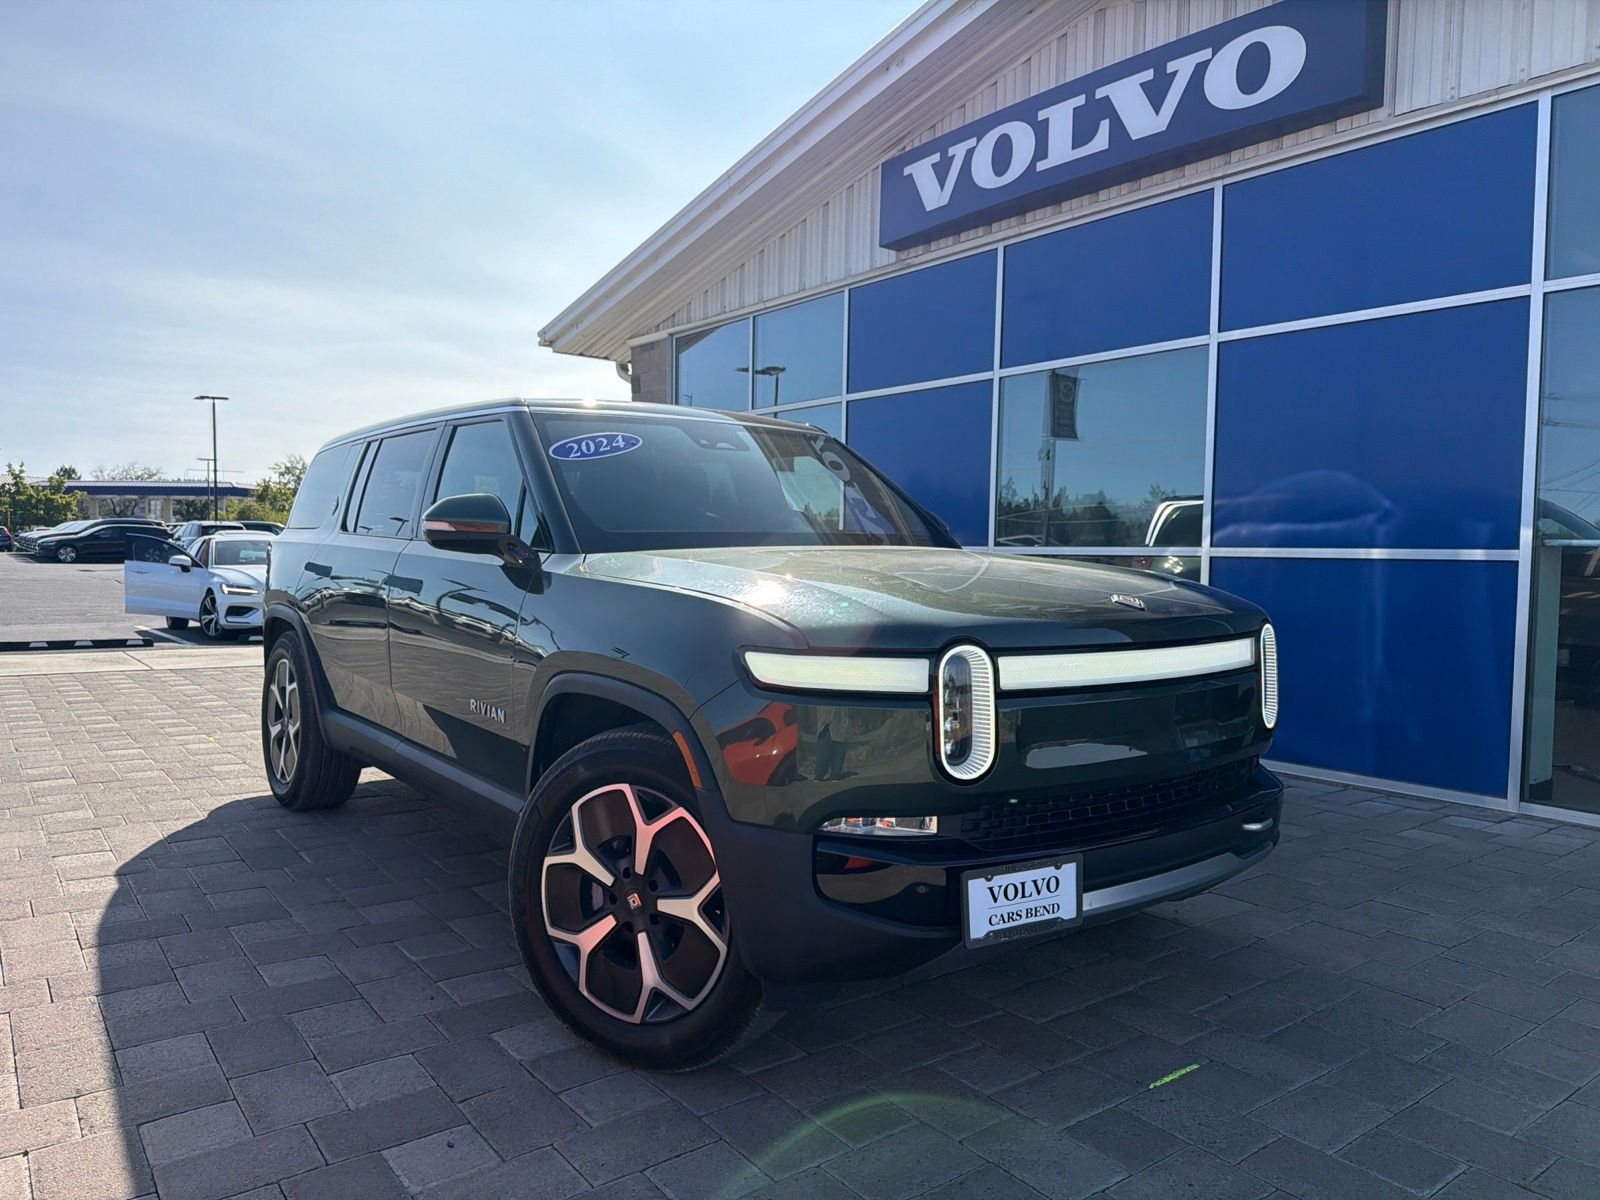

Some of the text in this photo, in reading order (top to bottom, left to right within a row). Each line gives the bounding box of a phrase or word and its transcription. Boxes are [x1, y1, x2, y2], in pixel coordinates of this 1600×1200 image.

[903, 25, 1306, 212] VOLVO
[566, 435, 625, 457] 2024
[470, 698, 506, 723] RIVIAN
[987, 875, 1060, 904] VOLVO
[988, 909, 1022, 927] CARS
[1025, 902, 1060, 919] BEND
